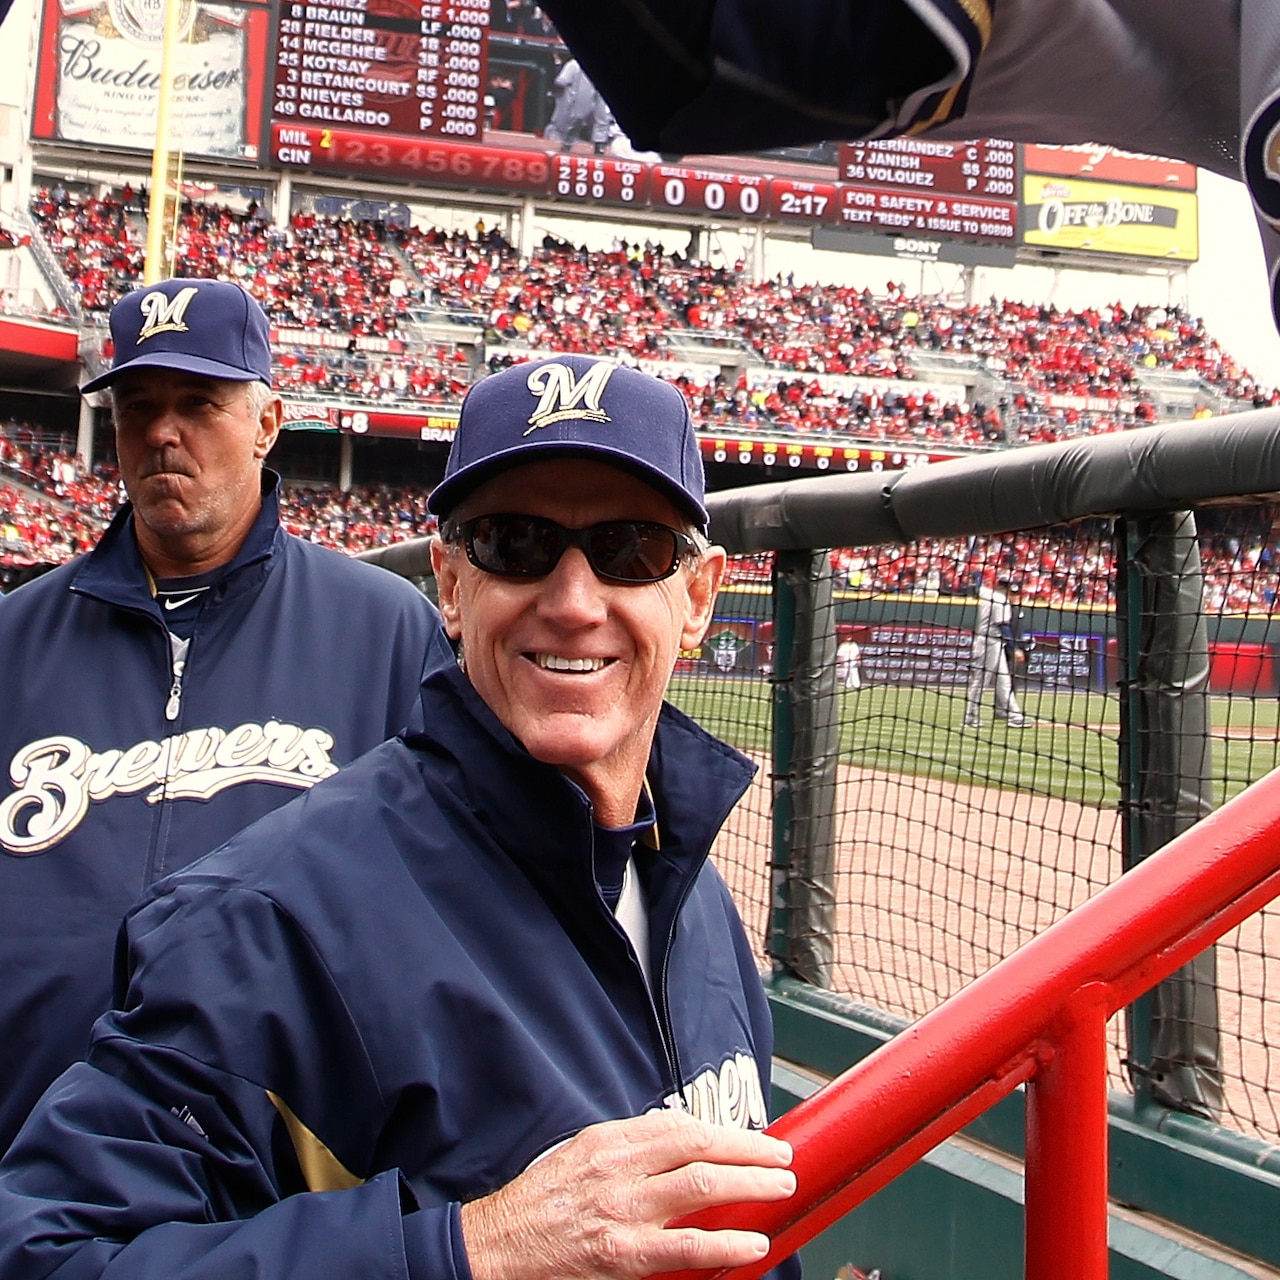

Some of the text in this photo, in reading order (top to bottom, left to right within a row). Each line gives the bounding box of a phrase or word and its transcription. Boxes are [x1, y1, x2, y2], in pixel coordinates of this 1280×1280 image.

[291, 4, 482, 41] 8 BRAUN LF .000
[421, 5, 442, 19] CF
[446, 8, 490, 26] 1.000
[280, 19, 480, 56] 28 FIELDER 1B .000
[280, 35, 480, 72] 14 MCGEHEE 3B .000
[278, 51, 480, 88] 25 KOTSAY RF .000
[104, 90, 156, 102] KING OF
[287, 69, 478, 104] 3 BETANCOURT SS .000
[276, 84, 478, 120] 33 NIEVES C .000
[274, 101, 477, 136] 49 GALLARDO P .000
[279, 129, 332, 148] MIL 2
[277, 148, 311, 164] CIN
[594, 159, 603, 170] E
[854, 150, 1014, 179] 7 JANISH SS .000
[868, 139, 954, 158] HERNANDEZ
[966, 148, 978, 160] C
[984, 151, 1014, 165] .000
[559, 166, 634, 186] 2 2 0 0
[660, 166, 761, 186] BALL STRIKE OUT
[792, 181, 815, 192] TIME
[846, 165, 1014, 195] 36 VOLQUEZ P .000
[558, 181, 634, 201] 0 0 0 0
[664, 179, 761, 214] 0 0 0
[780, 193, 828, 216] 2:17
[846, 192, 1010, 221] FOR SAFETY & SERVICE
[842, 209, 872, 222] TEXT
[916, 216, 925, 228] &
[928, 217, 961, 232] ISSUE
[963, 220, 978, 234] TO
[893, 238, 941, 254] SONY
[139, 286, 199, 337] M
[526, 361, 618, 422] M
[341, 411, 369, 434] #8
[714, 449, 726, 463] 0
[739, 451, 751, 464] 0
[763, 453, 776, 466] 0
[789, 454, 801, 468] 0
[817, 456, 830, 470] 0
[846, 458, 859, 471] 0
[871, 631, 904, 644] FIRST
[905, 632, 926, 645] AID
